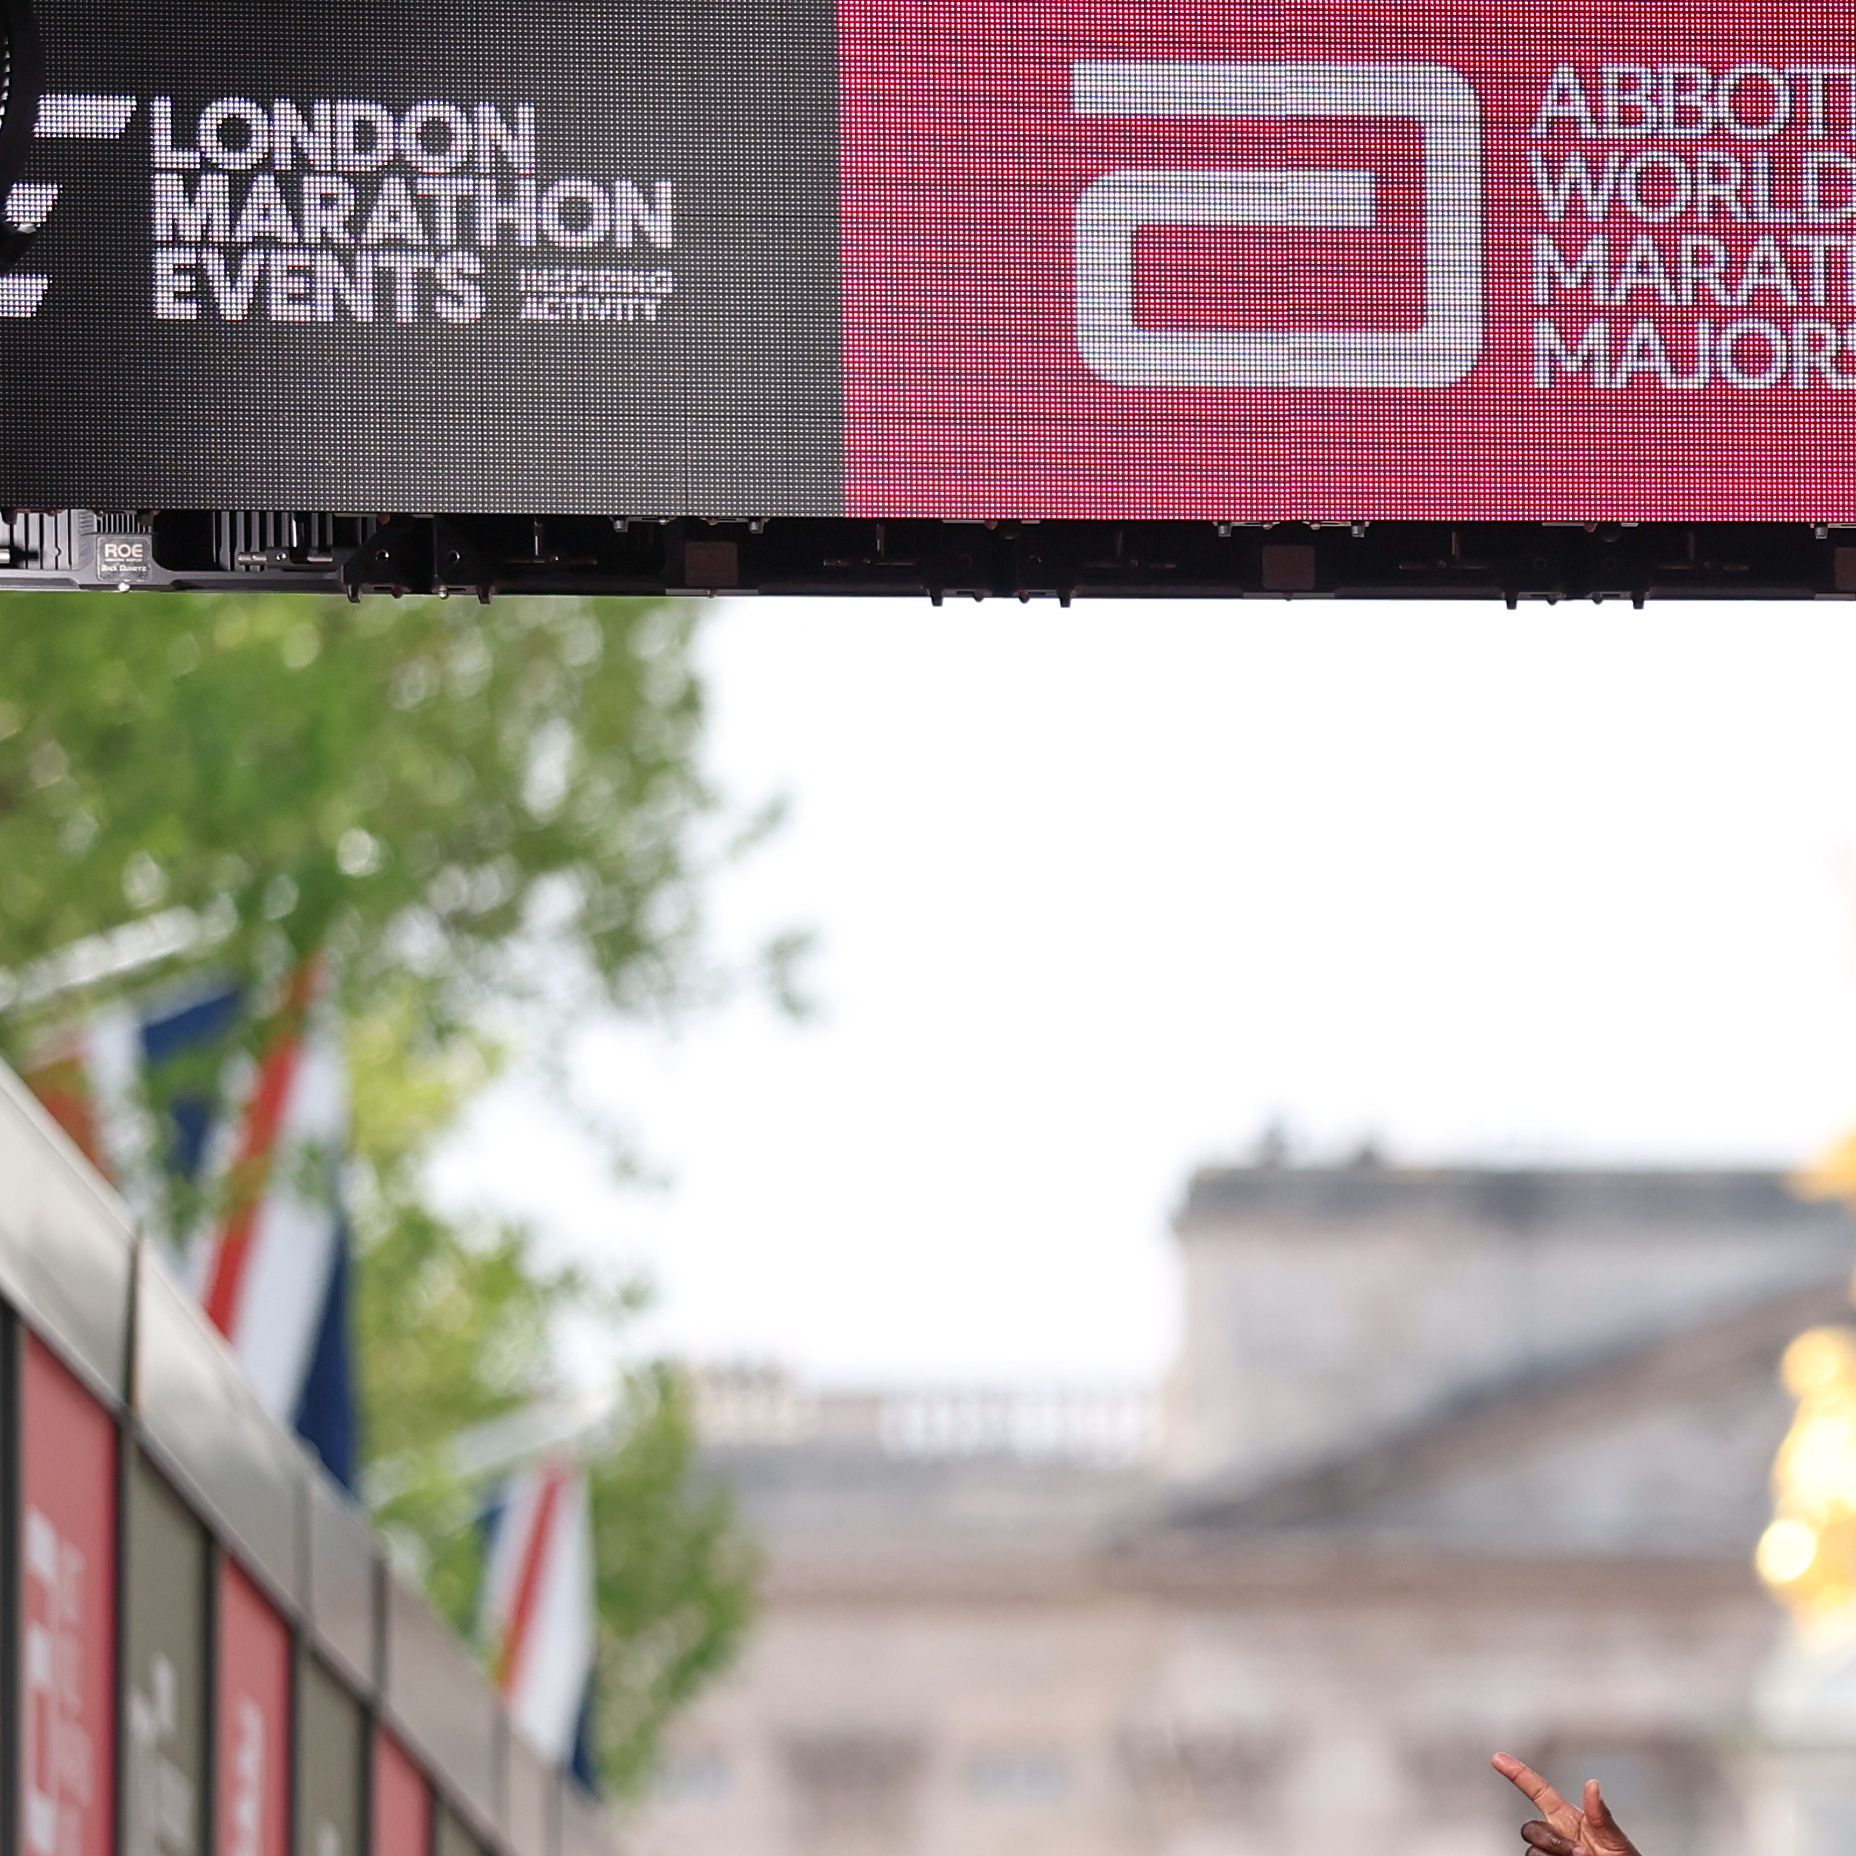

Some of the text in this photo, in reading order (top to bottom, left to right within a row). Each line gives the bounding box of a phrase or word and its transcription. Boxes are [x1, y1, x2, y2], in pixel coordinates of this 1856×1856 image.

[150, 94, 536, 175] LONDON
[150, 171, 674, 250] MARATHON
[151, 246, 486, 324] EVENTS
[104, 543, 143, 558] ROE
